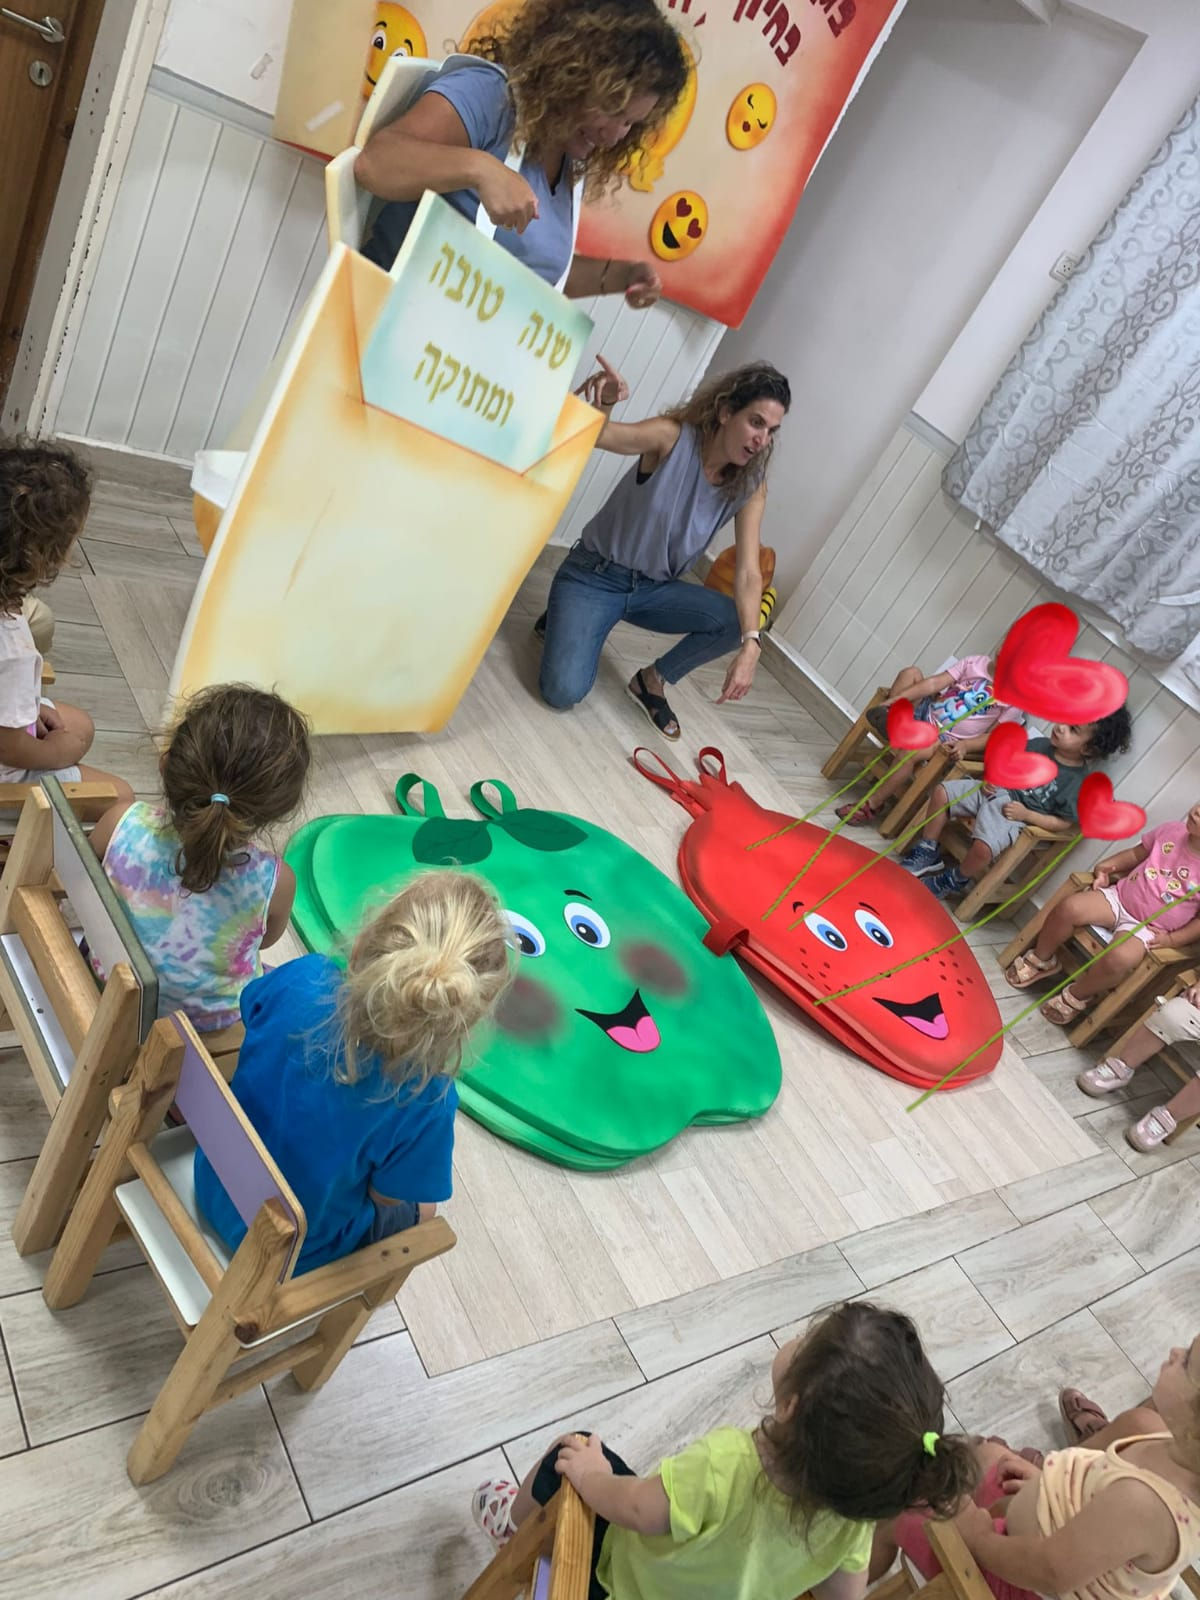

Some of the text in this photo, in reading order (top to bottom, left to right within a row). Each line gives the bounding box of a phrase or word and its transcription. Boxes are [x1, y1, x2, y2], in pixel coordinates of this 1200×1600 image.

[428, 241, 573, 371] שנה טובה
[413, 340, 516, 428] ומתוקה
